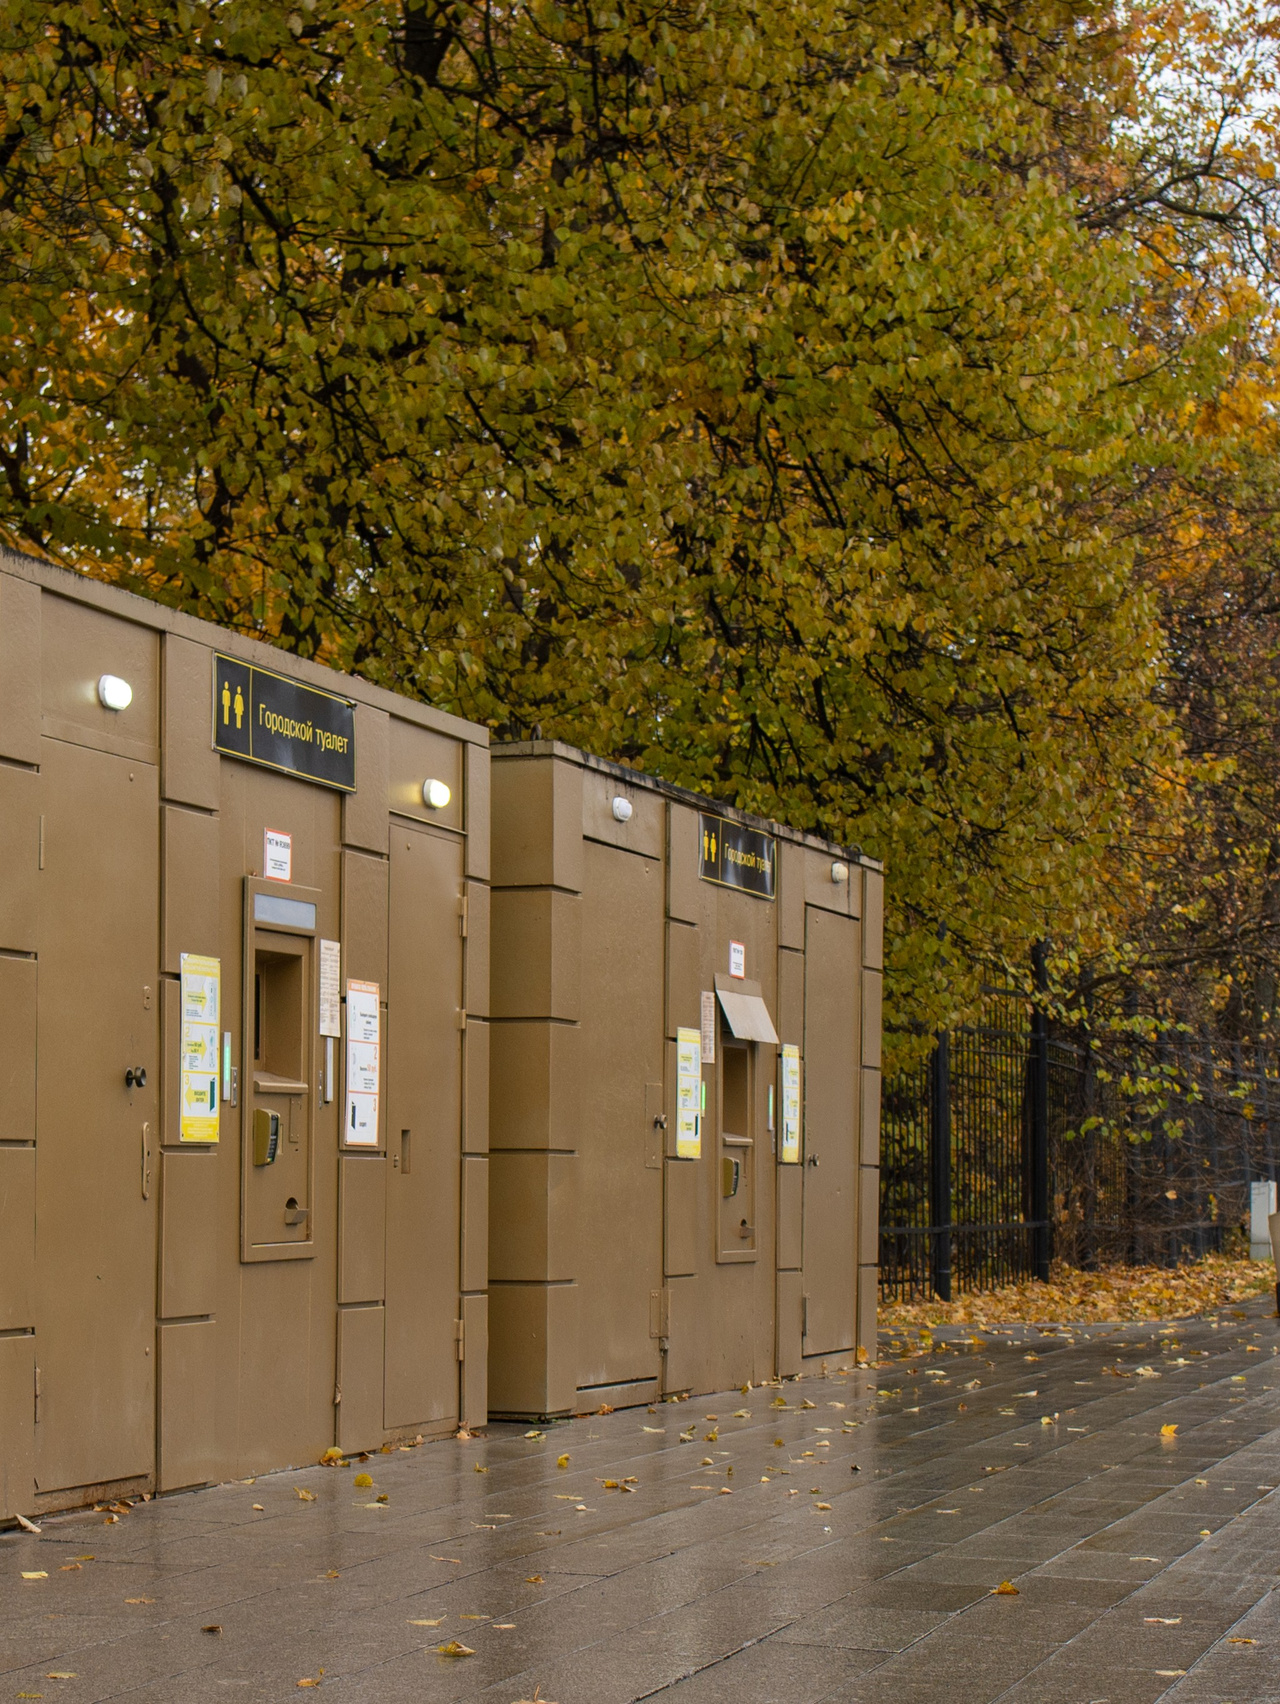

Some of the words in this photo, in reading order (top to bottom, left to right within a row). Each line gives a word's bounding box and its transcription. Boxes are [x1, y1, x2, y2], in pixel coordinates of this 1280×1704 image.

[259, 703, 313, 743] Городской
[316, 728, 349, 754] туалет
[756, 857, 771, 874] туа
